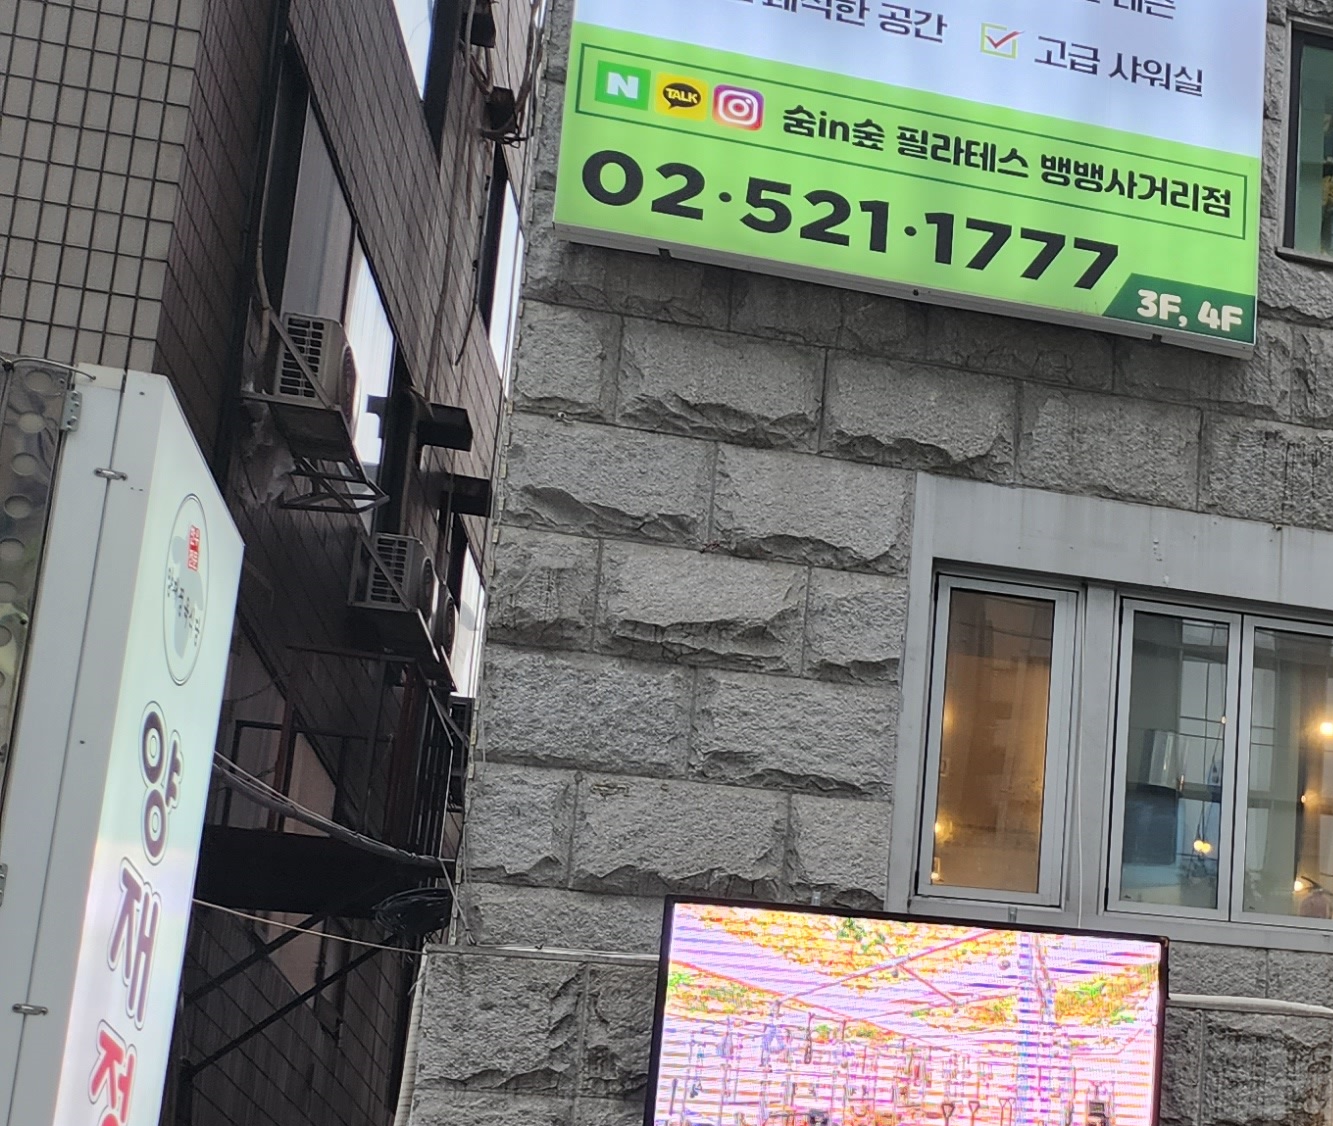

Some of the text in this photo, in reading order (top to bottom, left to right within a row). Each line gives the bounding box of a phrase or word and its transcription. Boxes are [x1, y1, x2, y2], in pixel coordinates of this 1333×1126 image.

[877, 7, 947, 45] 공간
[1034, 35, 1100, 75] 고급
[1108, 52, 1203, 97] 샤워실
[665, 86, 698, 105] TALK
[898, 126, 1030, 179] 필라테스
[1040, 152, 1232, 219] 뱅뱅사거리점
[1136, 288, 1244, 332] 3F, 4F
